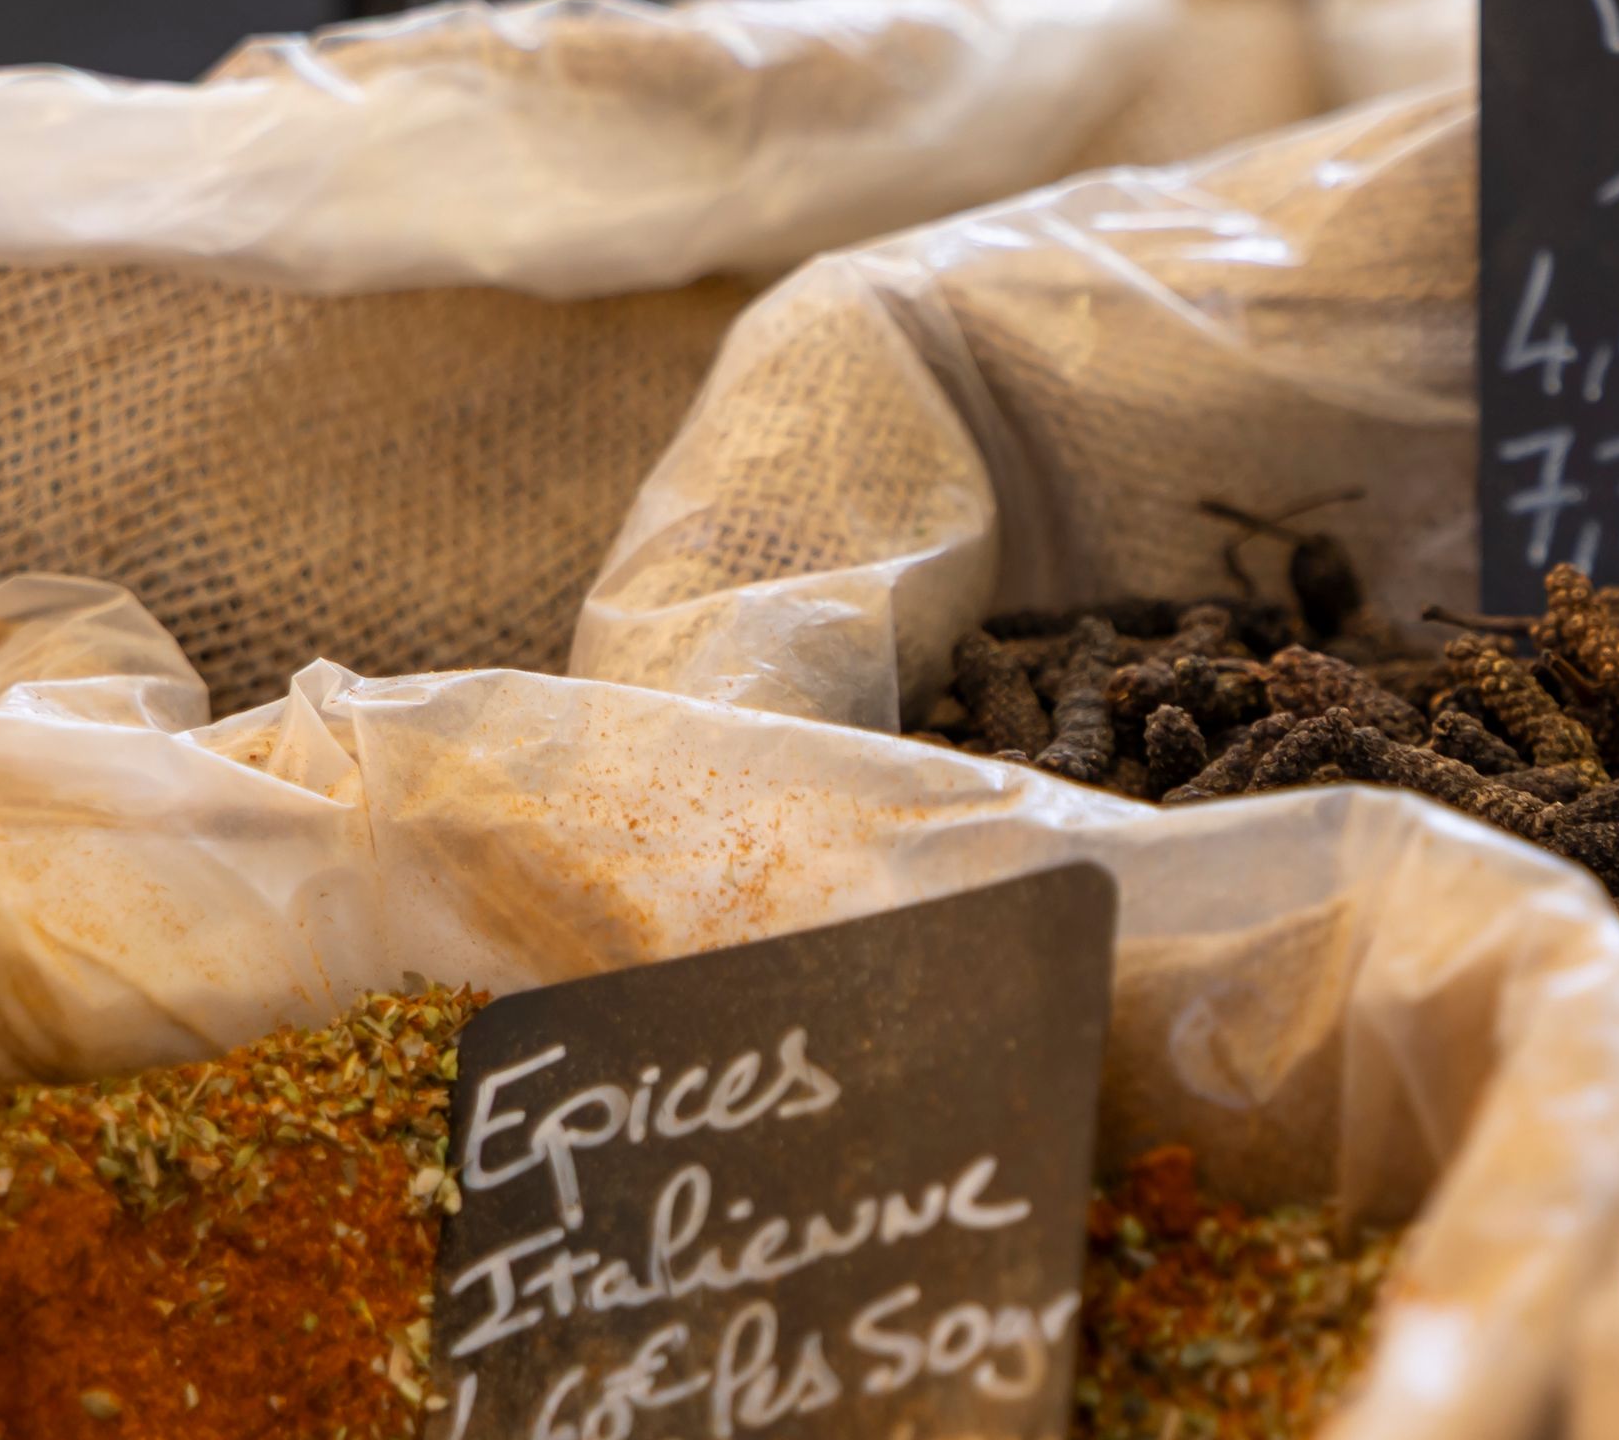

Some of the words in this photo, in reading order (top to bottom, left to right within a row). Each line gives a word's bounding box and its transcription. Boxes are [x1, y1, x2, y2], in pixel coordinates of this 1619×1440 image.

[461, 1023, 843, 1230] Epices
[448, 1154, 1032, 1360] Italienne
[710, 1297, 843, 1440] les
